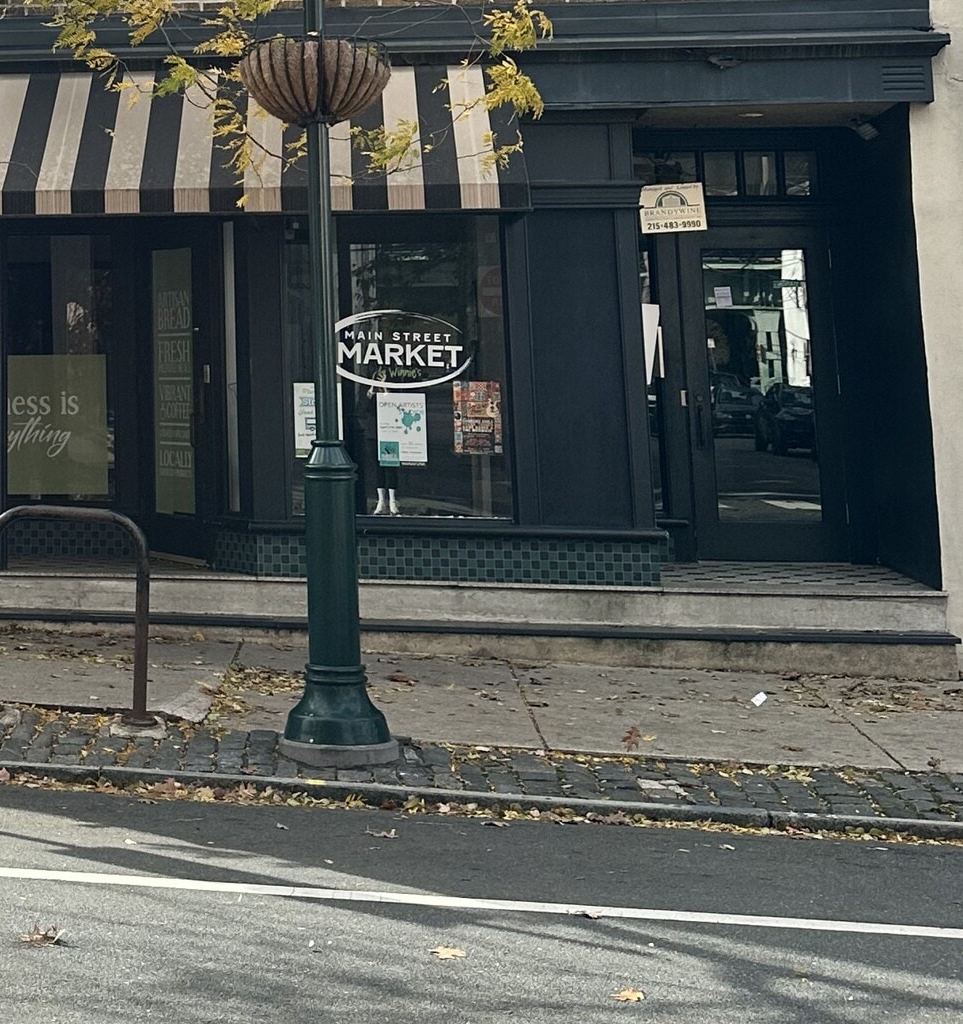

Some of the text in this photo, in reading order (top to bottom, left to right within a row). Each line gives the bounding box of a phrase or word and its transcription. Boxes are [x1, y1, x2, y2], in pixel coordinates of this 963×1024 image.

[644, 207, 702, 217] BRANDYWINE
[157, 307, 191, 330] BREAD
[344, 330, 452, 343] MAIN STREET
[158, 340, 191, 363] FRESH
[338, 342, 463, 368] MARKET
[60, 390, 79, 416] is
